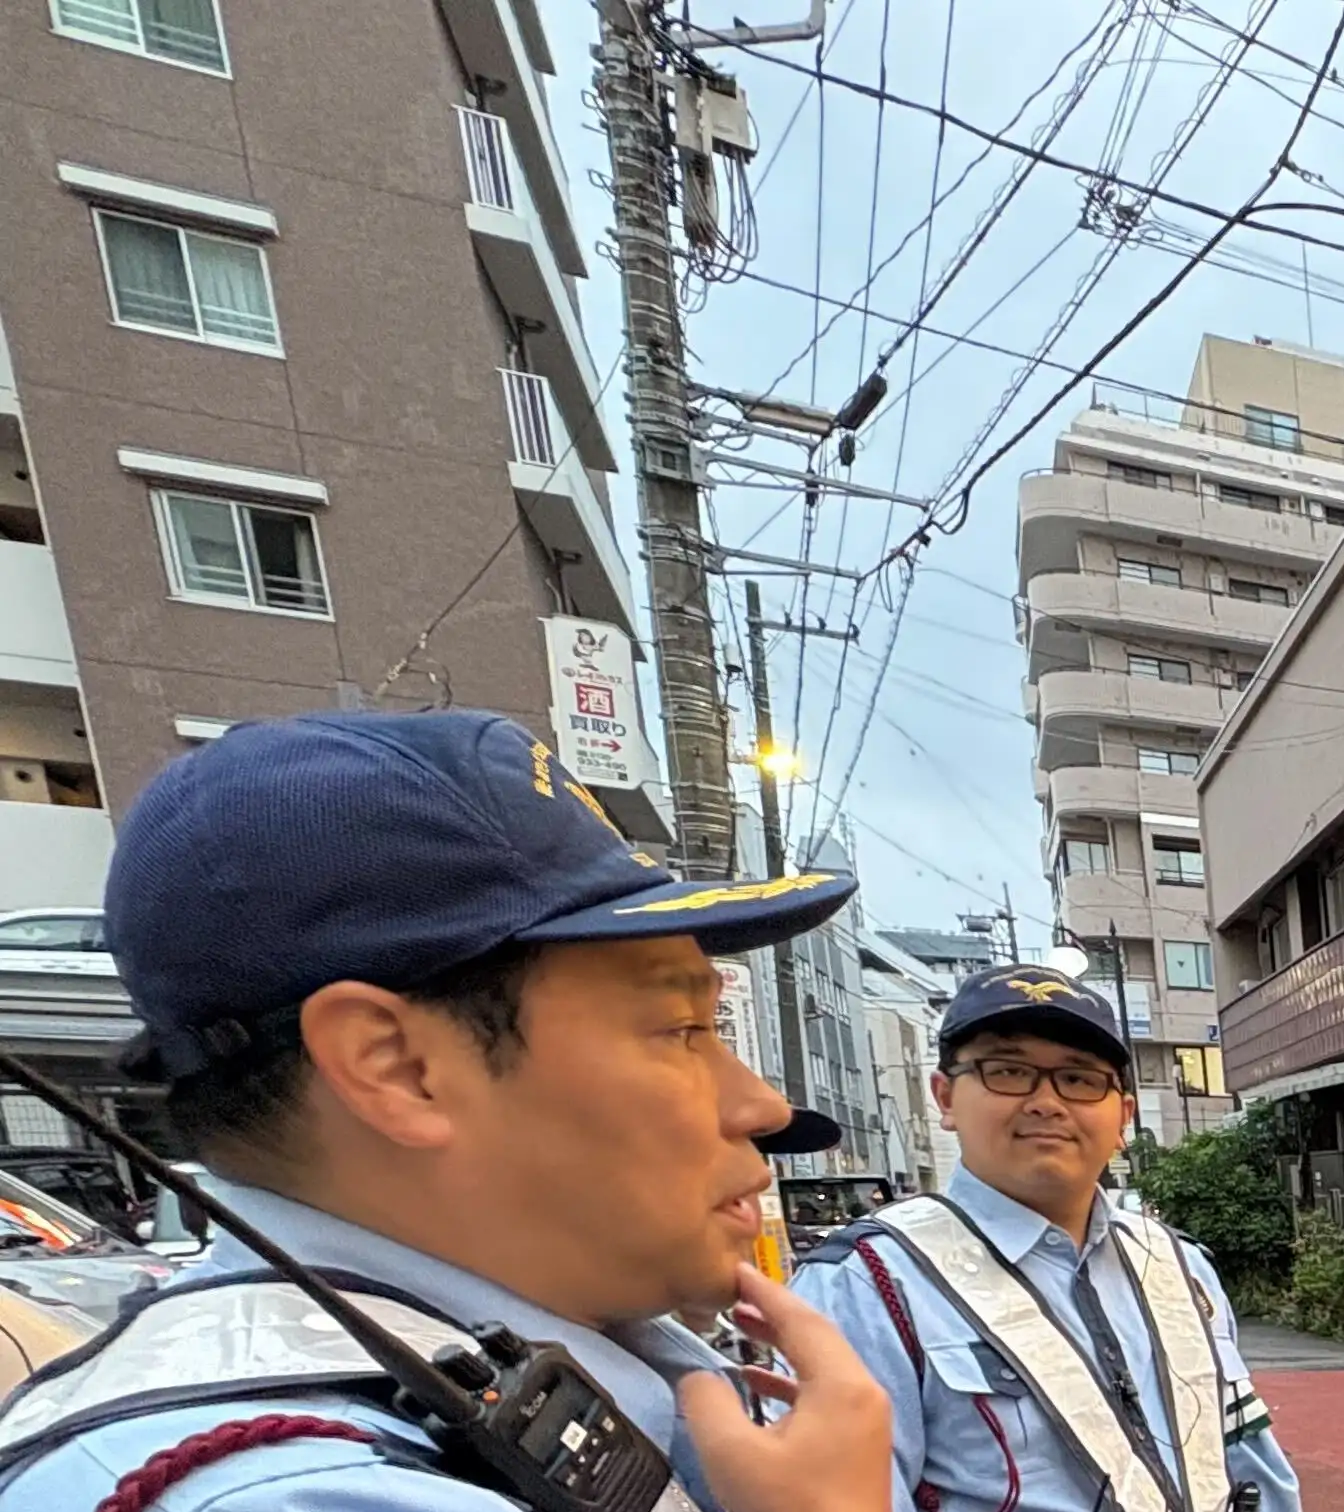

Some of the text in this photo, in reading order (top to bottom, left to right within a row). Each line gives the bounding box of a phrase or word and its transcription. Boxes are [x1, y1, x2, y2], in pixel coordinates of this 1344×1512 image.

[579, 685, 612, 715] 酒
[569, 714, 627, 738] 買取り
